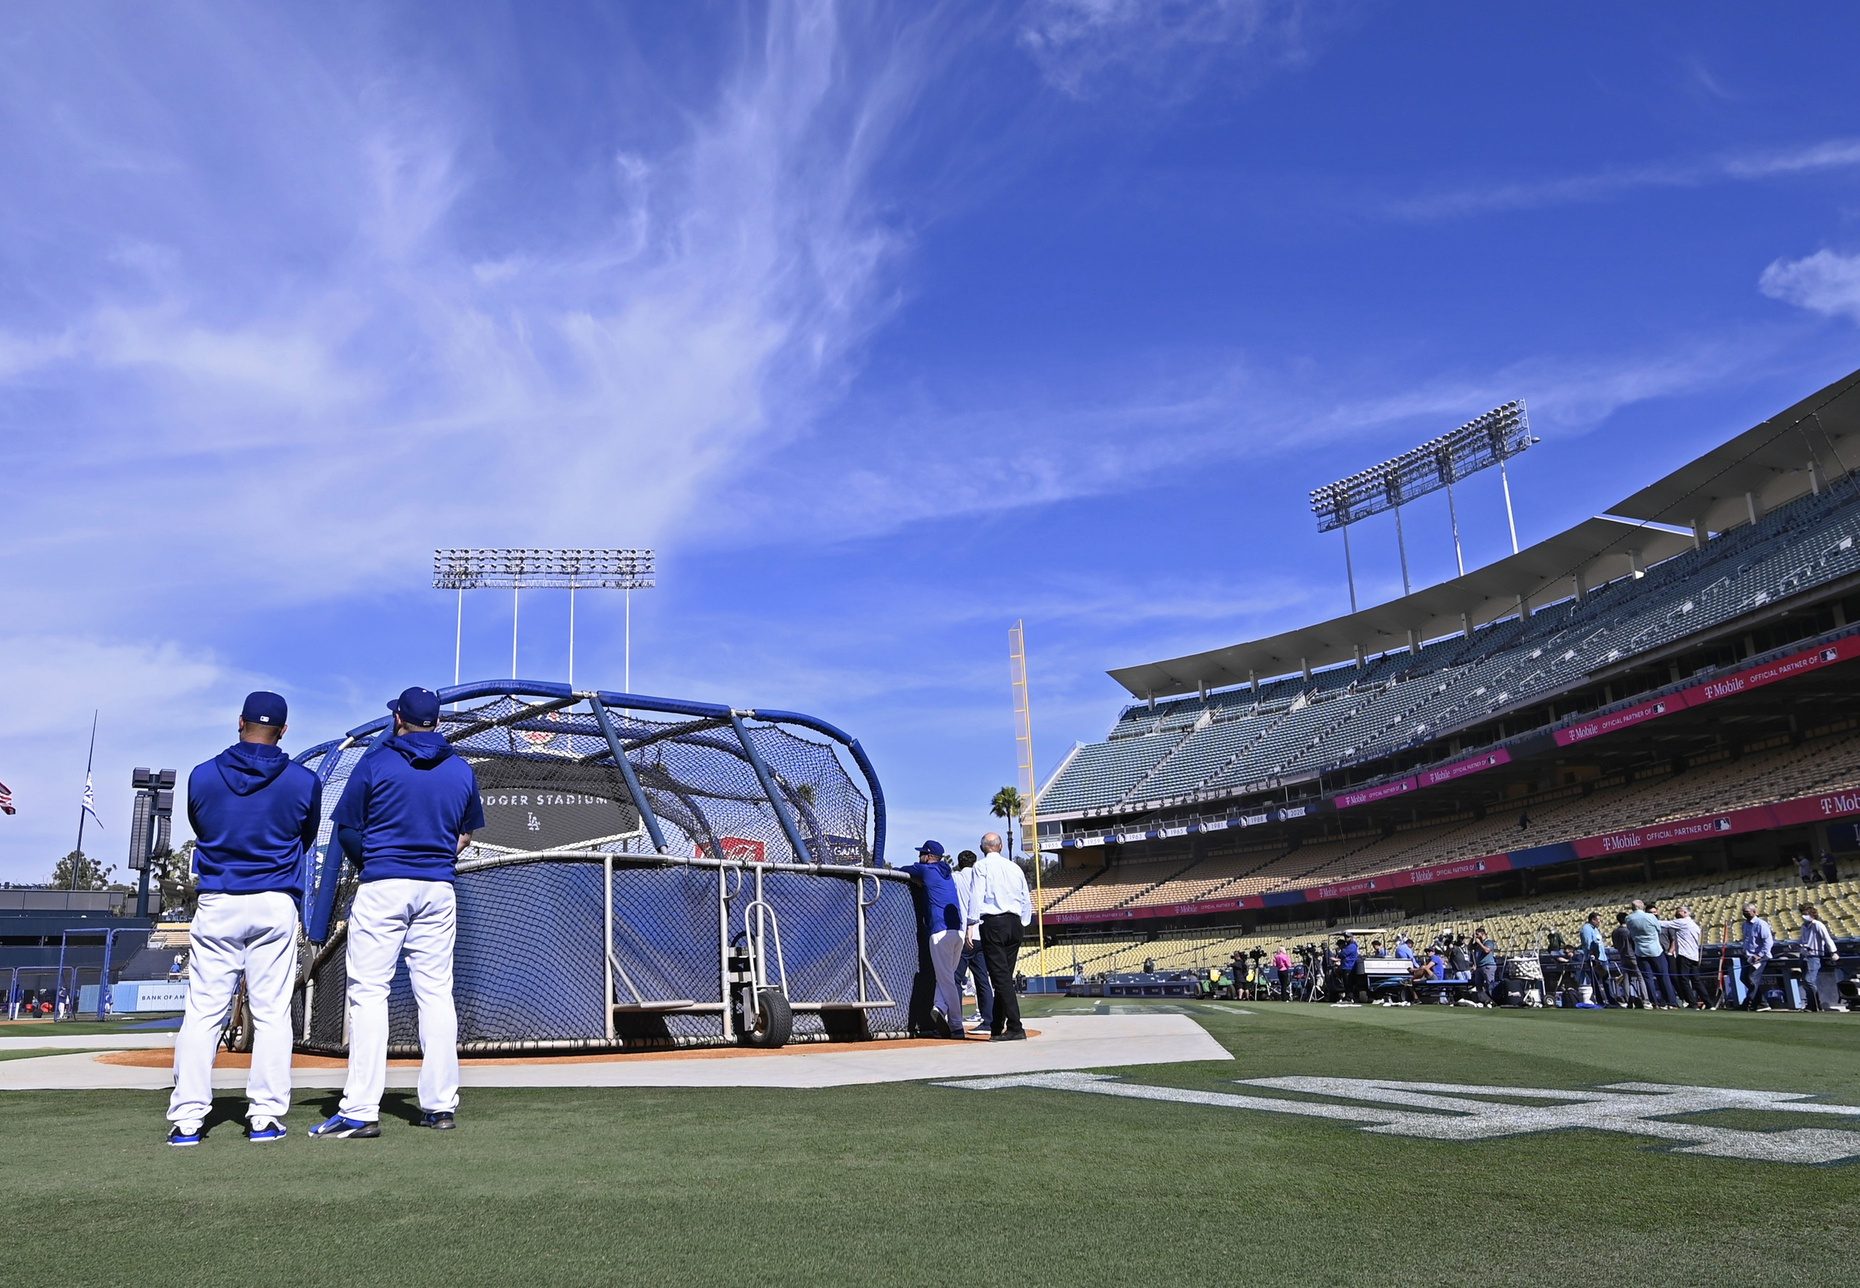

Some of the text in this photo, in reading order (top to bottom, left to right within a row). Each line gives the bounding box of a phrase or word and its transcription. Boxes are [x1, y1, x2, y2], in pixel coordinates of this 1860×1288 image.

[1750, 670, 1778, 683] OFFICIAL
[1778, 660, 1808, 674] PARTNER
[1808, 655, 1818, 664] OF
[1602, 719, 1623, 729] OFFICIAL
[1623, 711, 1644, 722] PARTNER
[480, 794, 608, 805] DGER STADIUM
[1160, 788, 1232, 807] STADIUM
[1245, 778, 1282, 793] CLUB
[1833, 793, 1860, 813] Mob
[1646, 832, 1673, 840] OFFICIAL
[1674, 825, 1702, 835] PARTNER
[1703, 823, 1712, 831] OF
[834, 846, 860, 856] GAME
